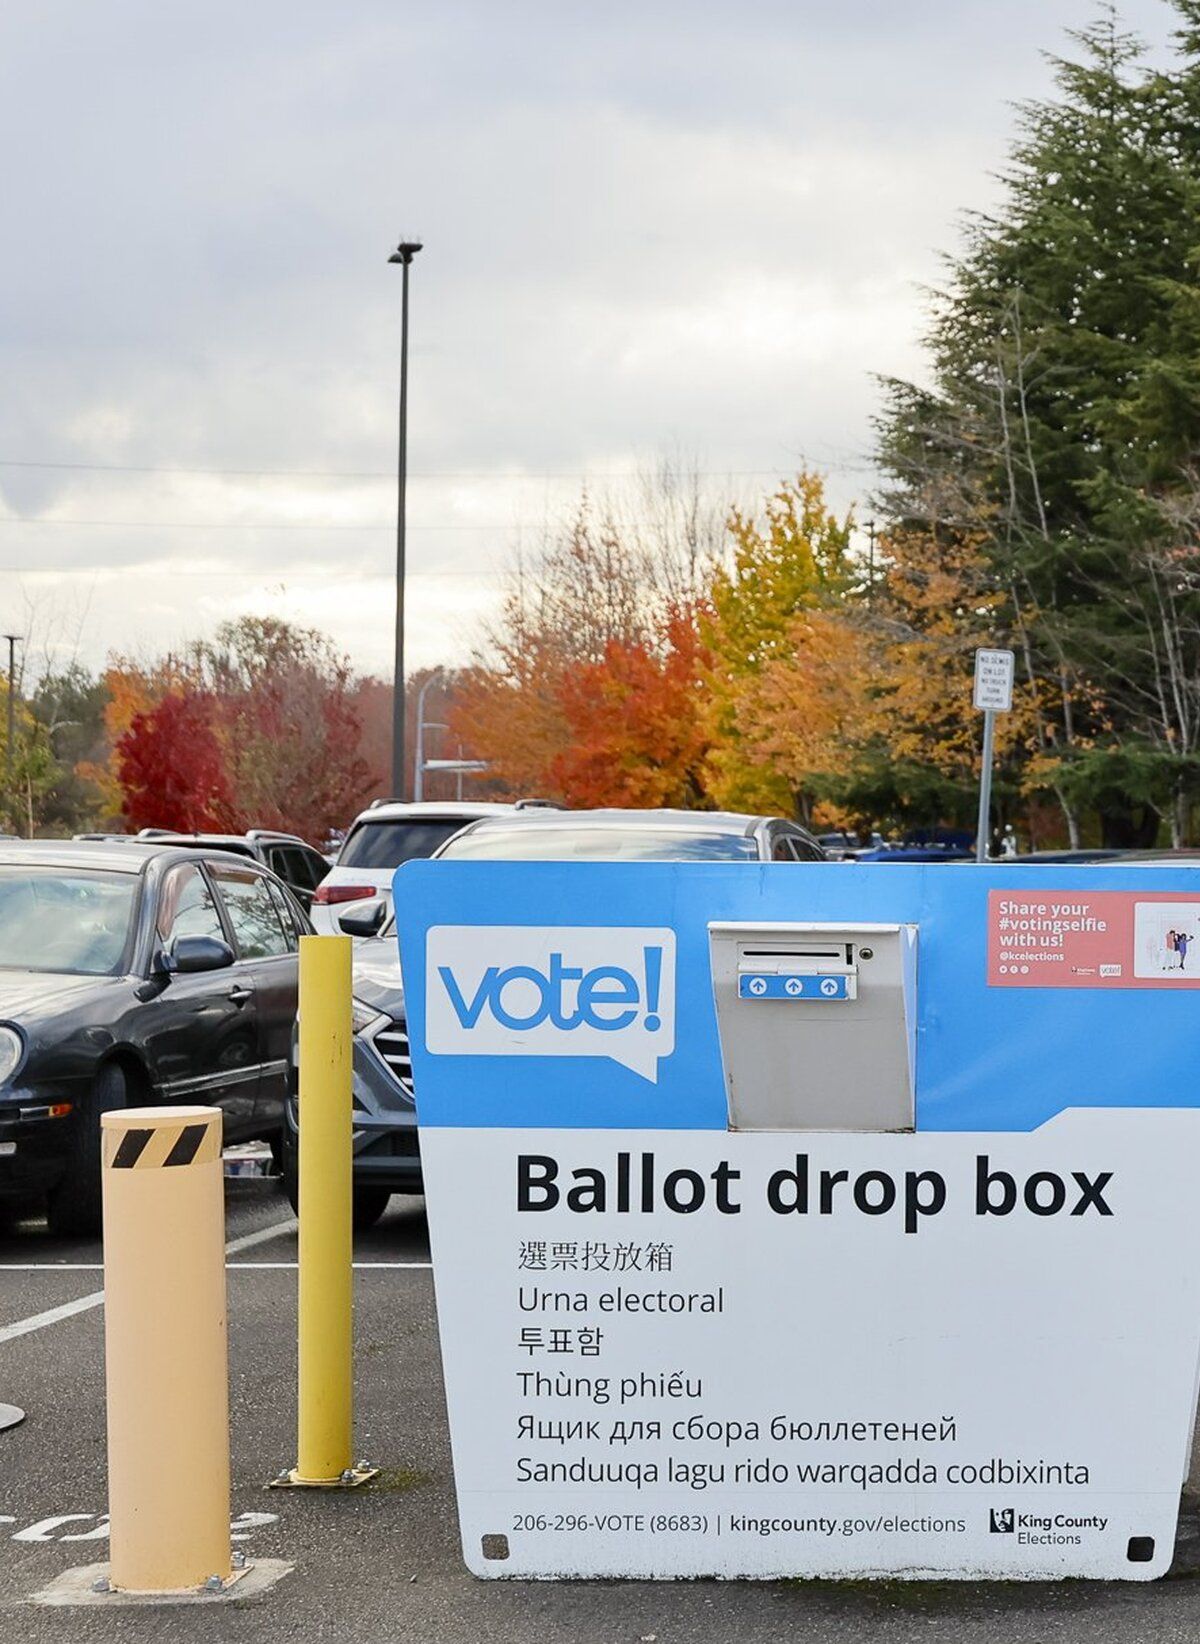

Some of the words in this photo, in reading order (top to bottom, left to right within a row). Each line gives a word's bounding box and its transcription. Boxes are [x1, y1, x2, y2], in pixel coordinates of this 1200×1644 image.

[998, 901, 1047, 916] Share
[1051, 904, 1090, 919] your
[998, 917, 1107, 935] #votingselfie
[999, 933, 1037, 947] with
[1040, 933, 1064, 947] us!
[999, 951, 1065, 962] @kcelections
[437, 945, 663, 1033] vote!
[517, 1152, 741, 1214] Ballot
[767, 1152, 947, 1234] drop
[975, 1154, 1114, 1217] box
[518, 1240, 674, 1272] 選票投放箱
[518, 1286, 588, 1312] Urna
[598, 1286, 723, 1313] electoral
[517, 1326, 604, 1357] 투표함
[516, 1370, 611, 1407] Thùng
[620, 1367, 702, 1407] phiếu
[516, 1414, 601, 1445] Ящик
[609, 1421, 661, 1446] для
[672, 1414, 760, 1448] сбора
[770, 1414, 956, 1443] бюллетеней
[516, 1456, 658, 1490] Sanduuqa
[668, 1456, 725, 1491] lagu
[734, 1457, 789, 1484] rido
[797, 1457, 937, 1491] warqadda
[946, 1457, 1089, 1485] codbixinta
[512, 1514, 645, 1532] 206-296-VOTE
[649, 1513, 709, 1535] (8683)
[730, 1513, 966, 1537] kingcounty.gov/elections
[1018, 1513, 1052, 1532] King
[1055, 1513, 1108, 1532] County
[1017, 1531, 1082, 1545] Elections
